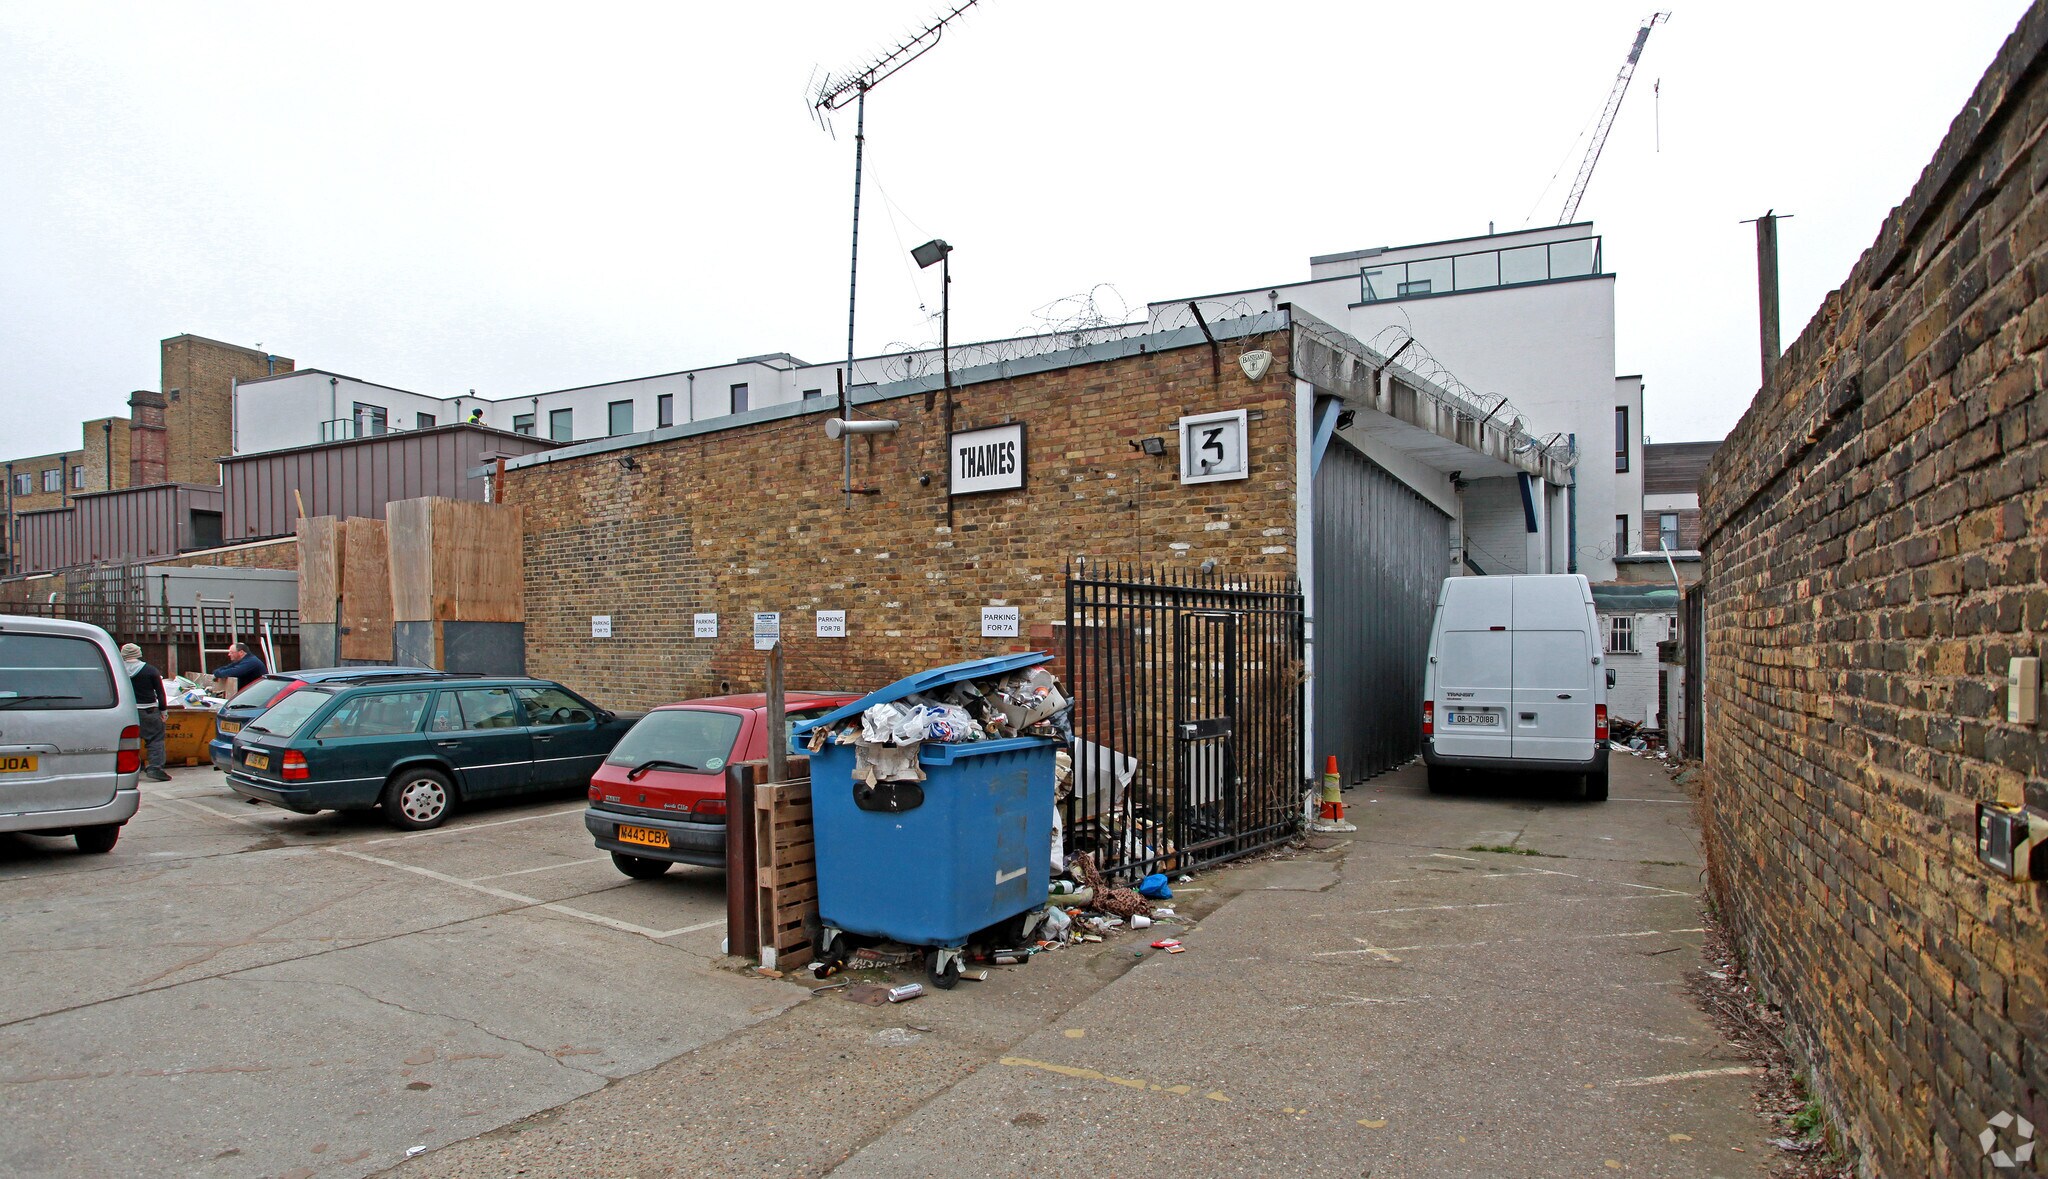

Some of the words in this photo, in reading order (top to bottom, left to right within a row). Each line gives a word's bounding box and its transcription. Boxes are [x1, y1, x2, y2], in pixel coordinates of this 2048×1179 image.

[960, 440, 1015, 479] THAMES
[1201, 427, 1224, 474] 3
[1457, 715, 1494, 723] 08-D-70188
[620, 826, 646, 841] M443
[647, 830, 668, 844] CBX
